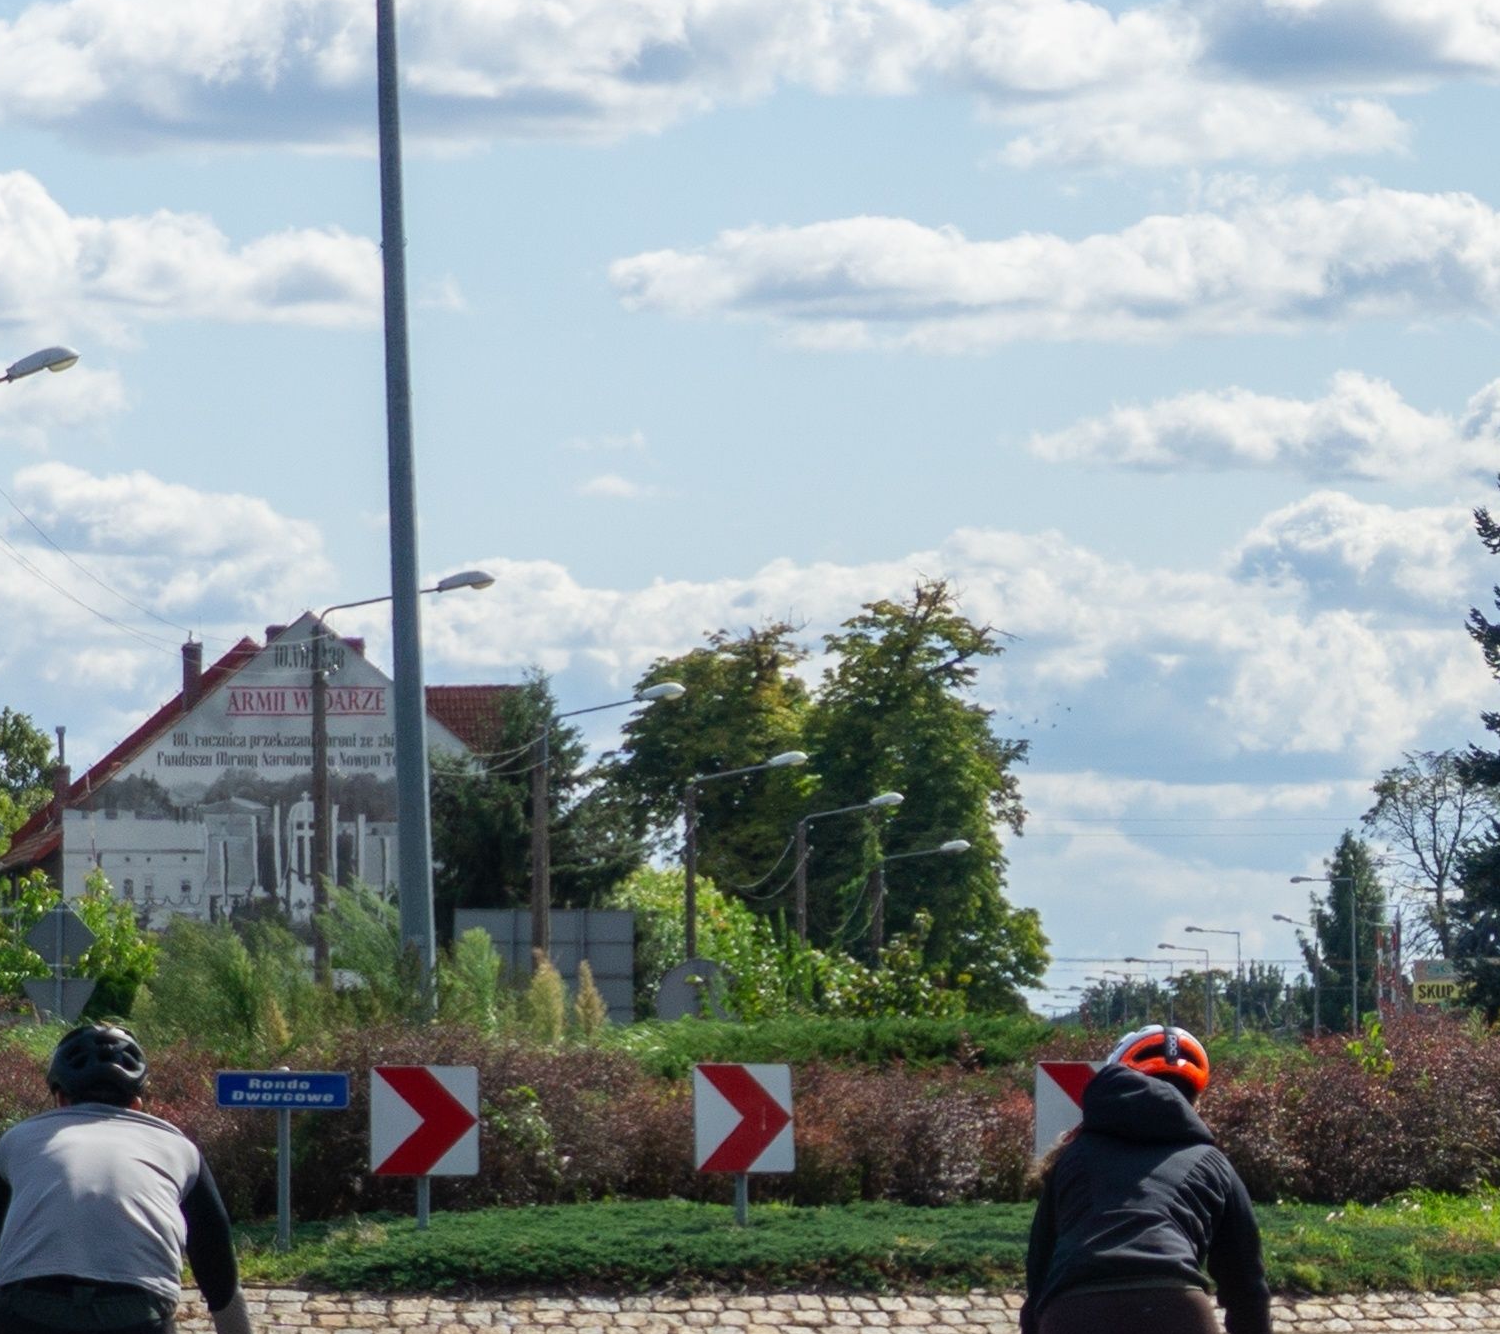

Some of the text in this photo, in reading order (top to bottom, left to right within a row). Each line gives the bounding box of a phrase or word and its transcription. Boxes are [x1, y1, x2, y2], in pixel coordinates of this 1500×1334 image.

[227, 690, 286, 712] ARMII
[248, 1078, 311, 1091] Rondo
[231, 1090, 335, 1103] Dworcowe
